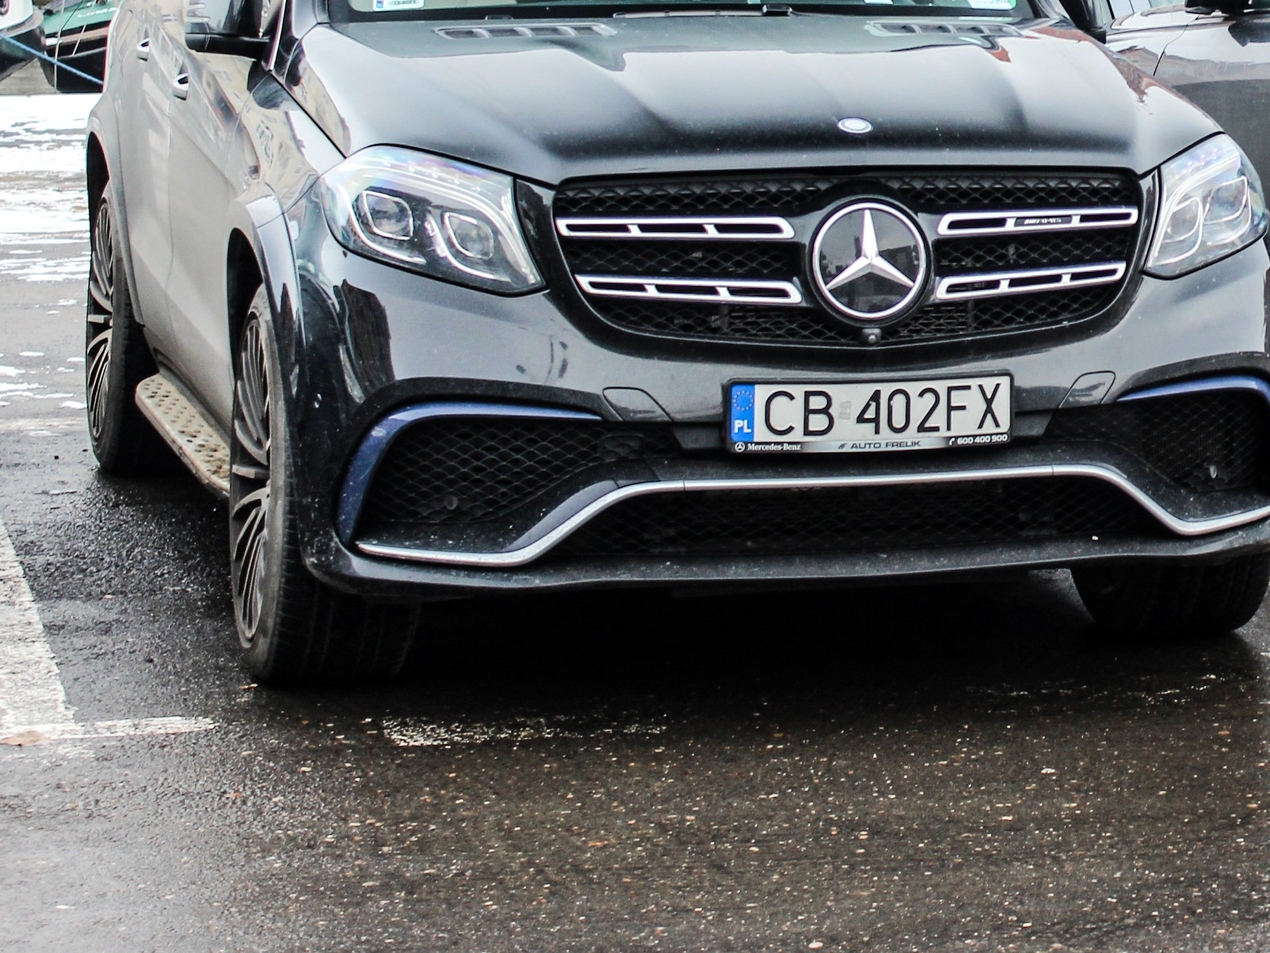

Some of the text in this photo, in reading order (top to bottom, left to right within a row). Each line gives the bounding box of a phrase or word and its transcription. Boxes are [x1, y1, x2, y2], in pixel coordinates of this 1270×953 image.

[764, 381, 1002, 437] CB 402FX
[734, 419, 752, 434] PL
[850, 440, 921, 450] AUTO FRELIK
[957, 433, 1008, 445] 600 400 900
[747, 442, 802, 452] Mercedes-Benz
